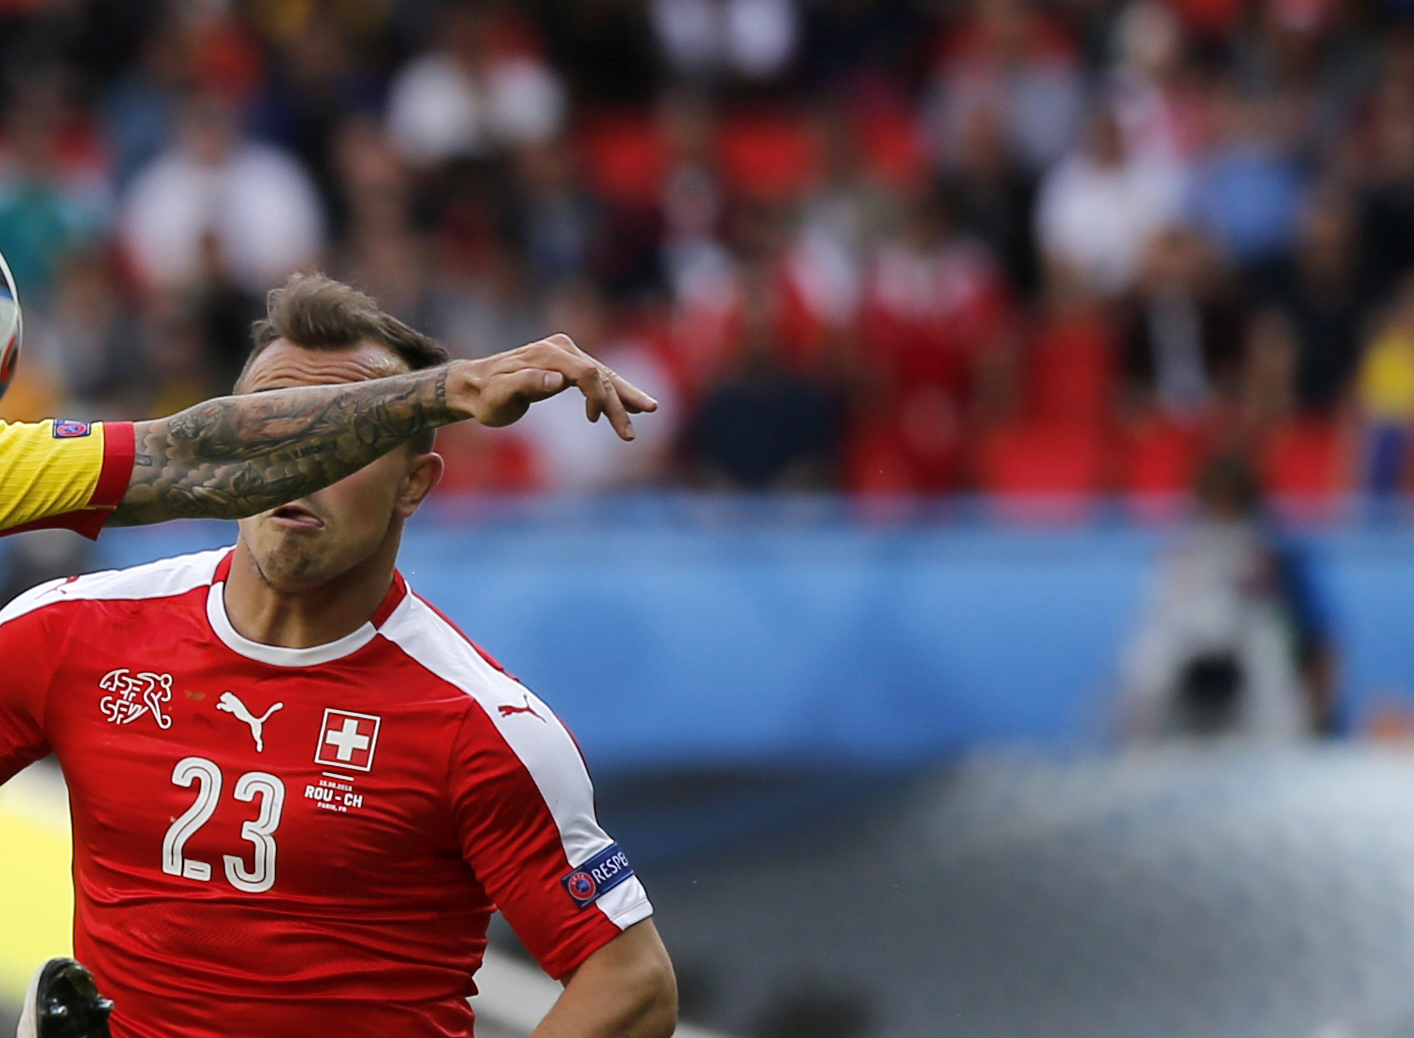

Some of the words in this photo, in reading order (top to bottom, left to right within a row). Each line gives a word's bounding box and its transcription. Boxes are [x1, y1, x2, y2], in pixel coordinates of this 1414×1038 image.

[162, 756, 285, 893] 23
[304, 785, 334, 802] ROU
[343, 792, 363, 808] CH
